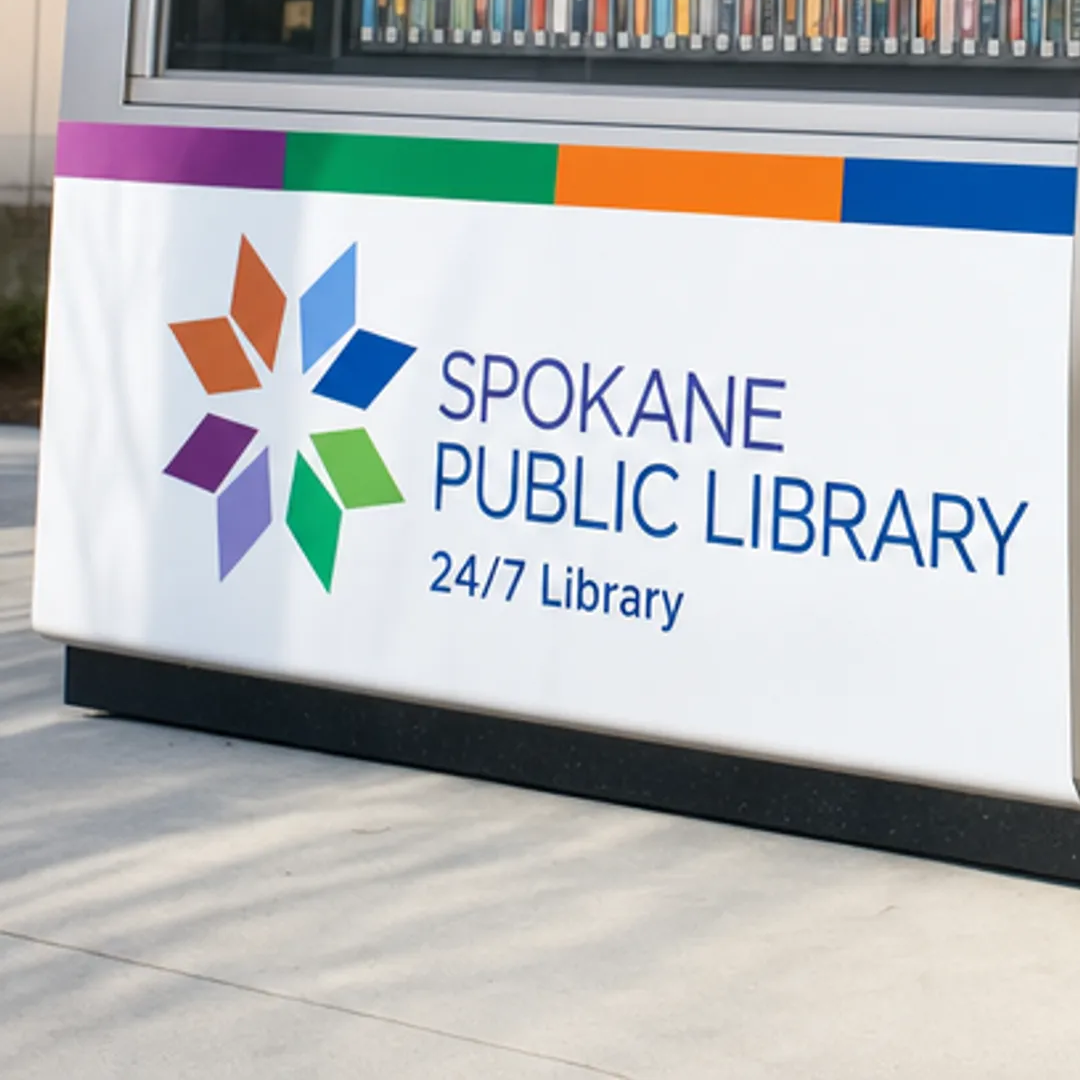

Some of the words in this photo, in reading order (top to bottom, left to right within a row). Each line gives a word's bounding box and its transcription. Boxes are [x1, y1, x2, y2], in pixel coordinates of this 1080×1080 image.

[438, 350, 787, 452] SPOKANE
[434, 441, 680, 539] PUBLIC
[705, 469, 1029, 576] LIBRARY
[429, 550, 526, 602] 24/7
[541, 563, 685, 633] Library
